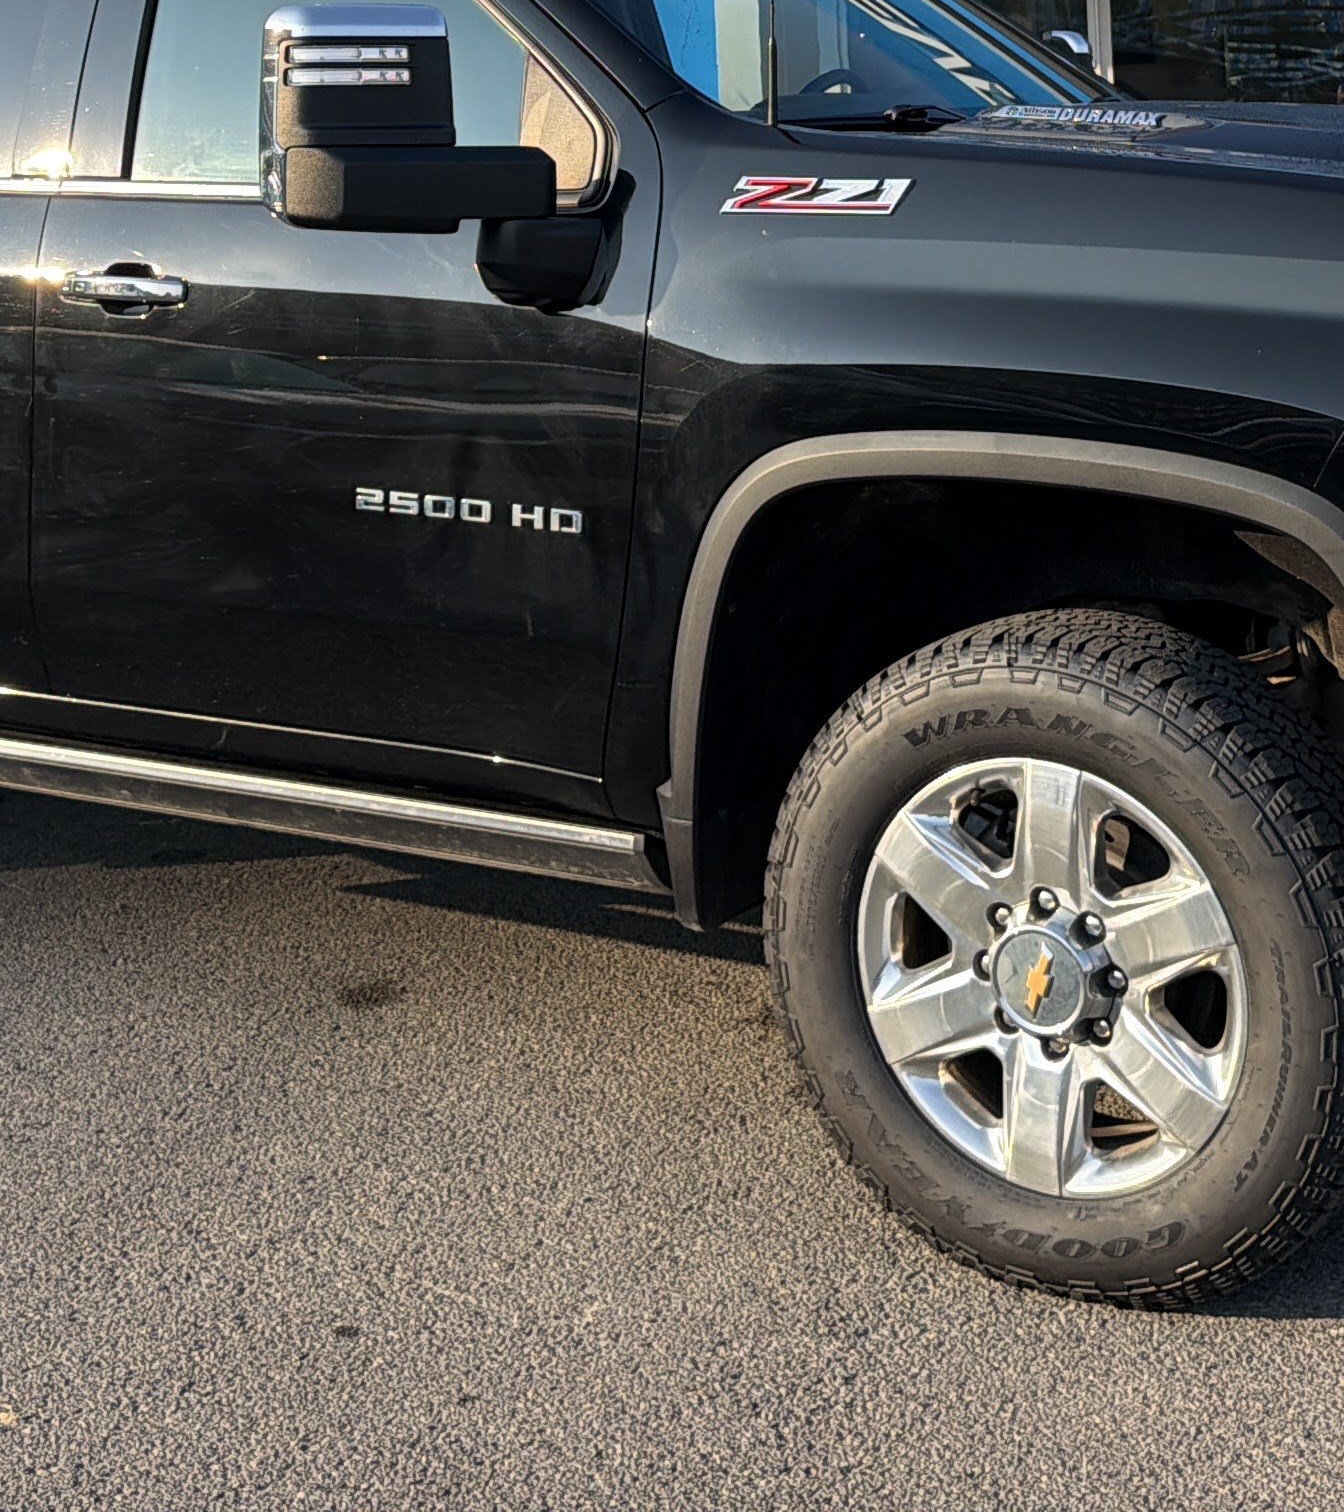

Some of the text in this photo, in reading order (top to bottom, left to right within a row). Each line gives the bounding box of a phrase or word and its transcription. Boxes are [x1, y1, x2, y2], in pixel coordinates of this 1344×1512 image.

[1058, 107, 1160, 126] DURAMAX
[718, 175, 915, 215] Z71
[355, 487, 583, 534] 2500 HD
[902, 706, 1251, 878] WRANGLER
